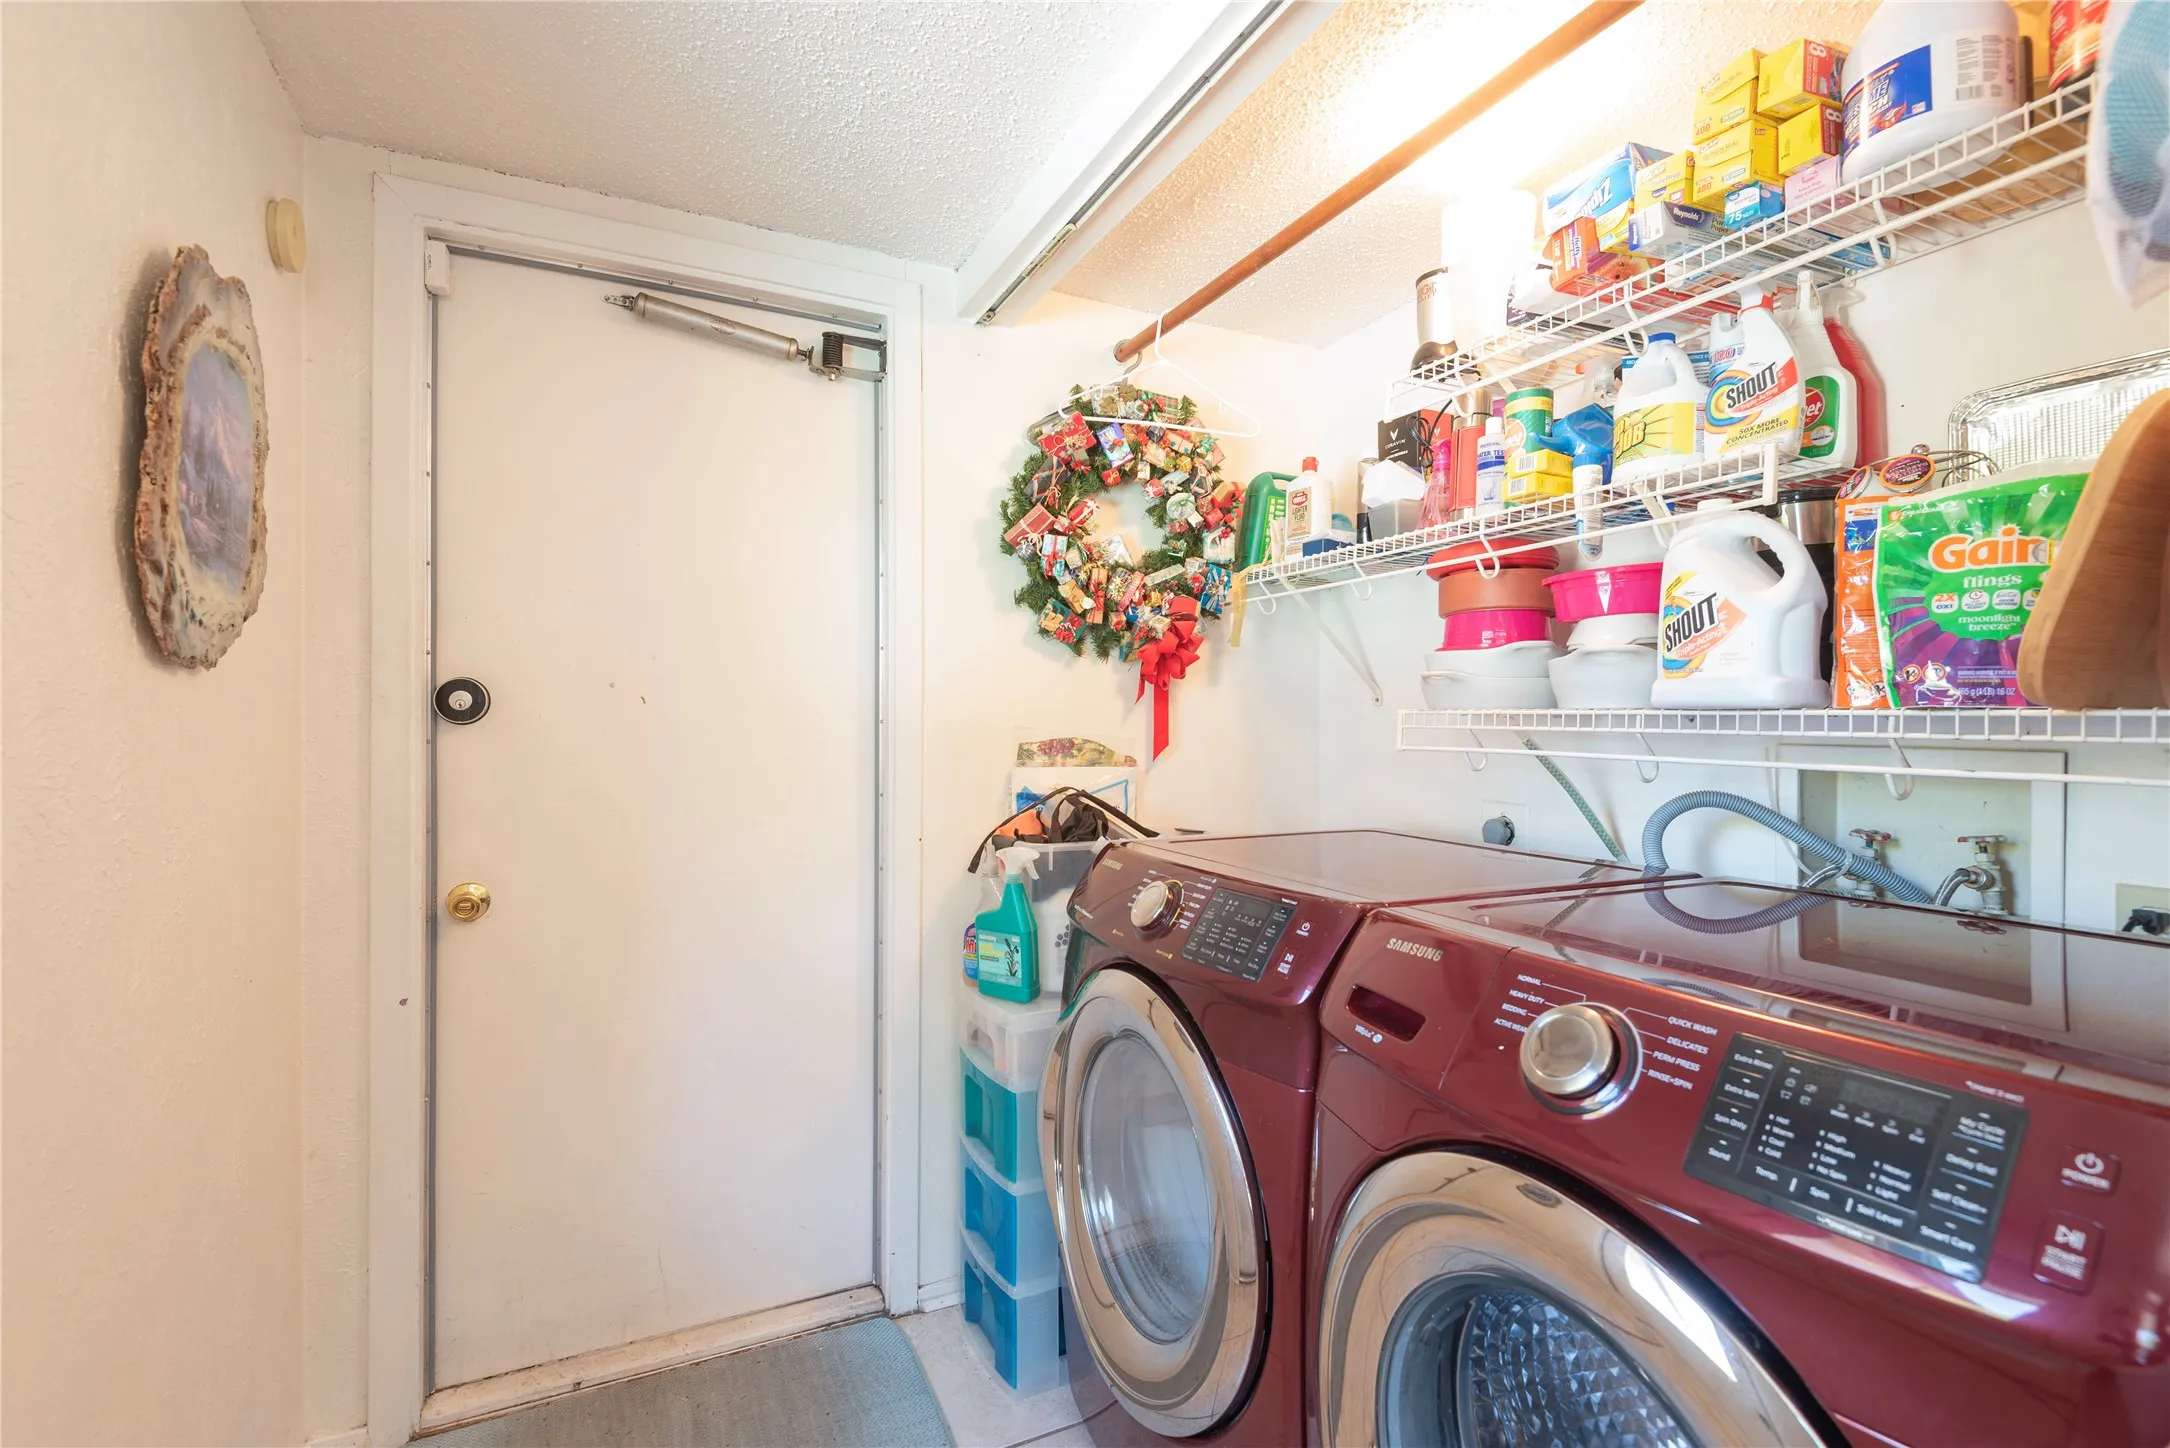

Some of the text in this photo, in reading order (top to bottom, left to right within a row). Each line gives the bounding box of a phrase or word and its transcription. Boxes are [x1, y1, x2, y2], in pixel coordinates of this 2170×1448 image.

[1673, 207, 1700, 222] Reynolds
[1728, 213, 1743, 224] 75
[1725, 361, 1777, 409] SHOUT
[1756, 416, 1780, 430] MORE
[1616, 422, 1647, 459] JOB
[1726, 419, 1789, 445] CONCENTRATED
[1963, 574, 2022, 589] flings
[1935, 593, 1957, 602] 2X
[1665, 592, 1717, 653] SHOUT
[1958, 614, 2021, 623] moonlight
[1102, 858, 1123, 871] SAMSUNG
[1386, 938, 1443, 961] SAMSUNG
[1517, 974, 1541, 986] NORMAL
[1509, 989, 1545, 1004] HEAVY DUTY
[1501, 1003, 1528, 1016] BEDDING
[1494, 1018, 1512, 1028] ACTIVE
[1668, 1016, 1718, 1036] QUICK WASH
[1666, 1036, 1709, 1055] DELICATES
[1653, 1051, 1701, 1072] PERM PRESS
[1724, 1083, 1761, 1100] Extra Spin
[1713, 1113, 1748, 1131] Spin Only
[1827, 1131, 1848, 1144] High
[1708, 1147, 1732, 1162] Sound
[1816, 1165, 1848, 1182] No Spin
[1882, 1163, 1912, 1180] Heavy
[1945, 1153, 1999, 1177] Delay End
[1879, 1174, 1912, 1192] Normal
[2061, 1168, 2111, 1190] POWER
[1809, 1186, 1830, 1201] Spin
[1875, 1186, 1899, 1201] Light
[1931, 1188, 1952, 1203] Self
[1856, 1203, 1876, 1218] Soil
[1875, 1211, 1904, 1228] Level
[1919, 1225, 1977, 1254] Smart Care
